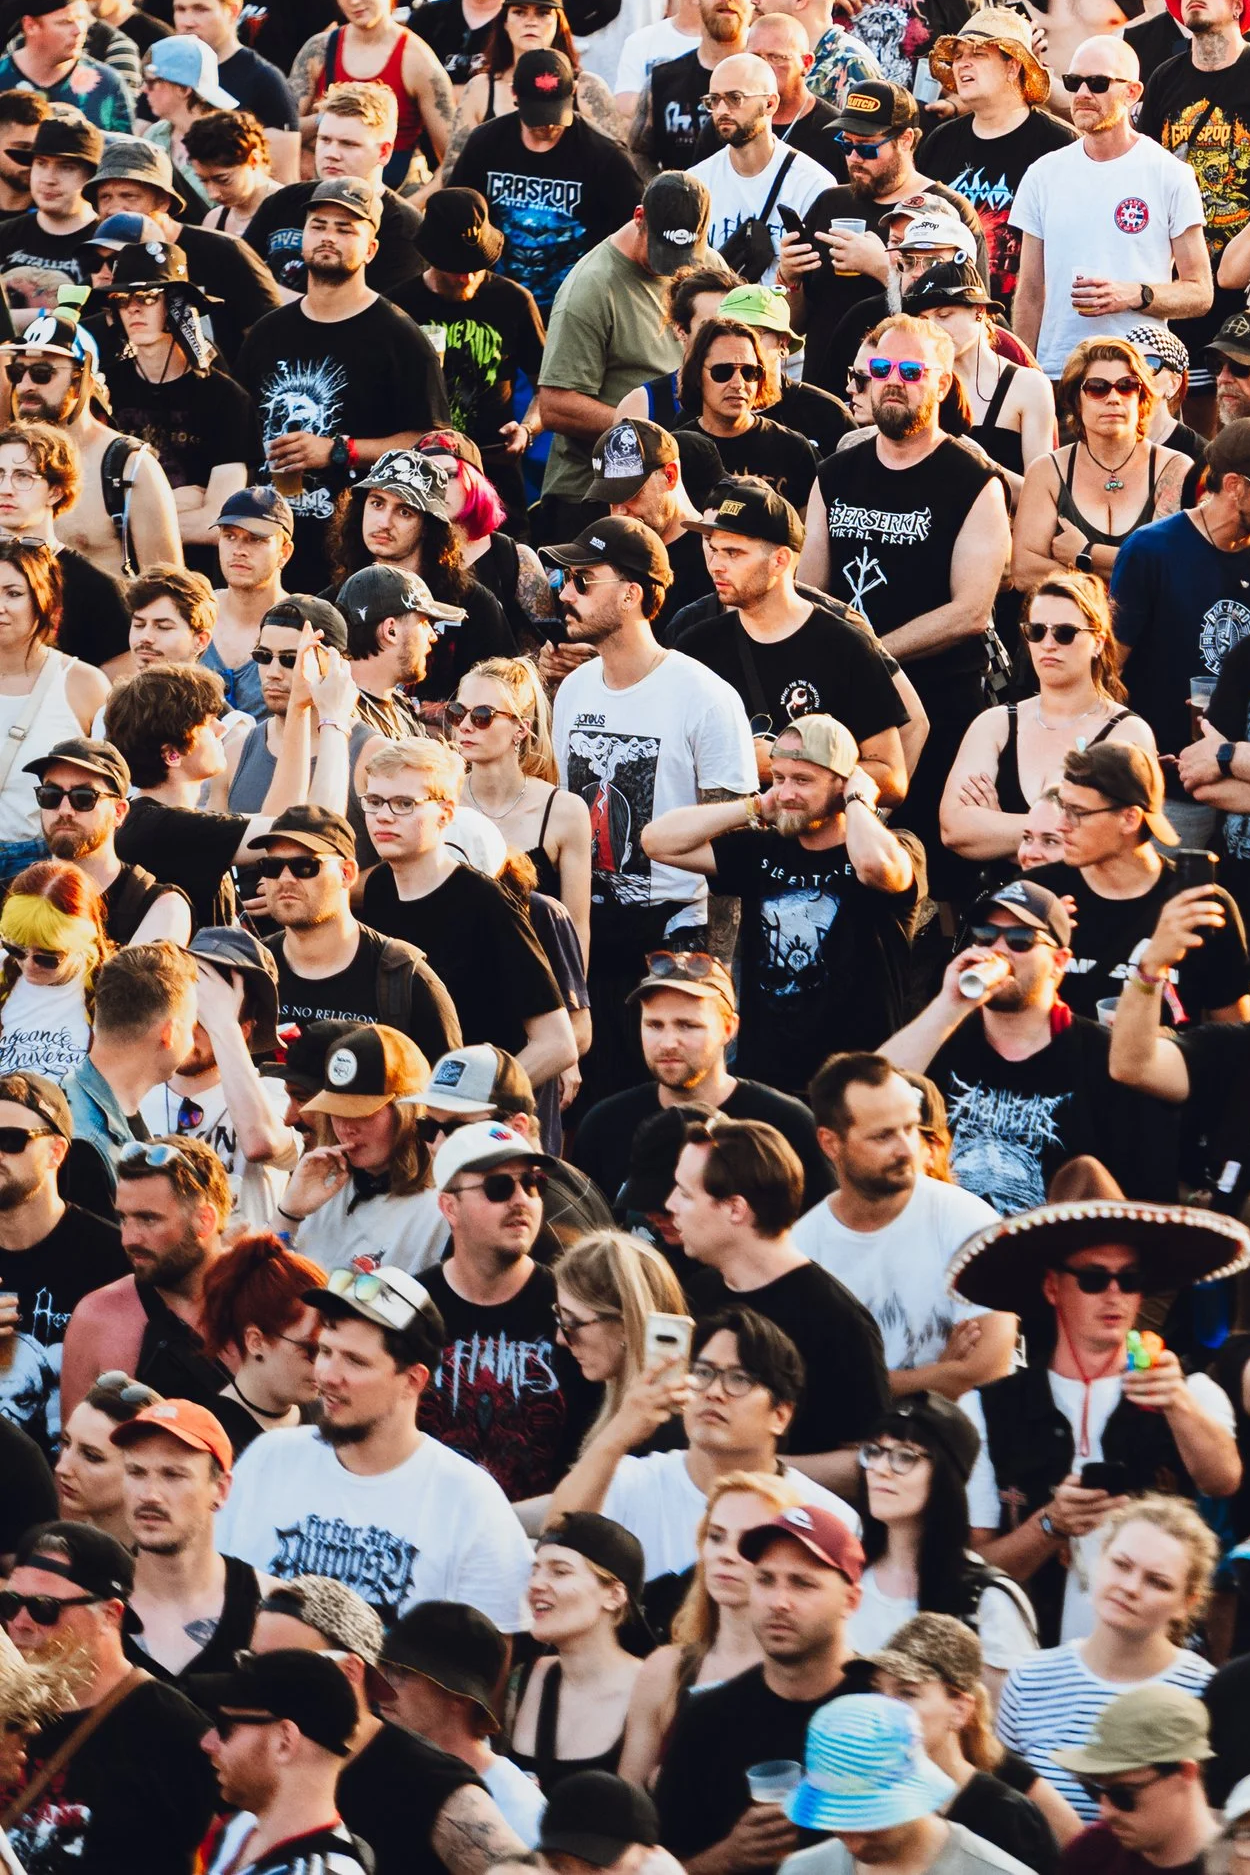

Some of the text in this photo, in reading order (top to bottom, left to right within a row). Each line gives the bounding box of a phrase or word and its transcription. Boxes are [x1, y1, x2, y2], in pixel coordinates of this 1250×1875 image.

[487, 171, 583, 217] GRASPOP
[291, 1006, 313, 1019] NO
[0, 1046, 86, 1069] Universi
